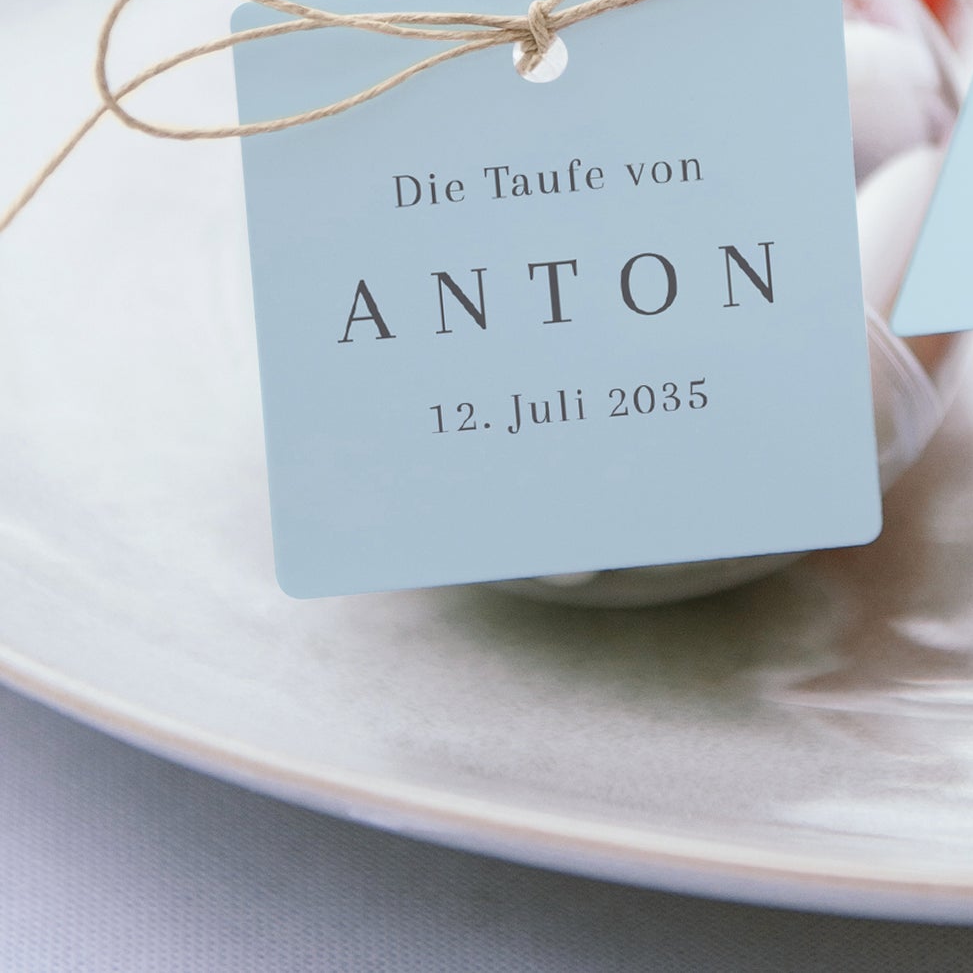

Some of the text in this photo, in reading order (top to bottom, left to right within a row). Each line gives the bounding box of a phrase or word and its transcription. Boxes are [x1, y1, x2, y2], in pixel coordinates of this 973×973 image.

[392, 157, 705, 209] Die Taufe von
[337, 241, 776, 344] ANTON
[429, 377, 709, 435] 12. Juli 2035
